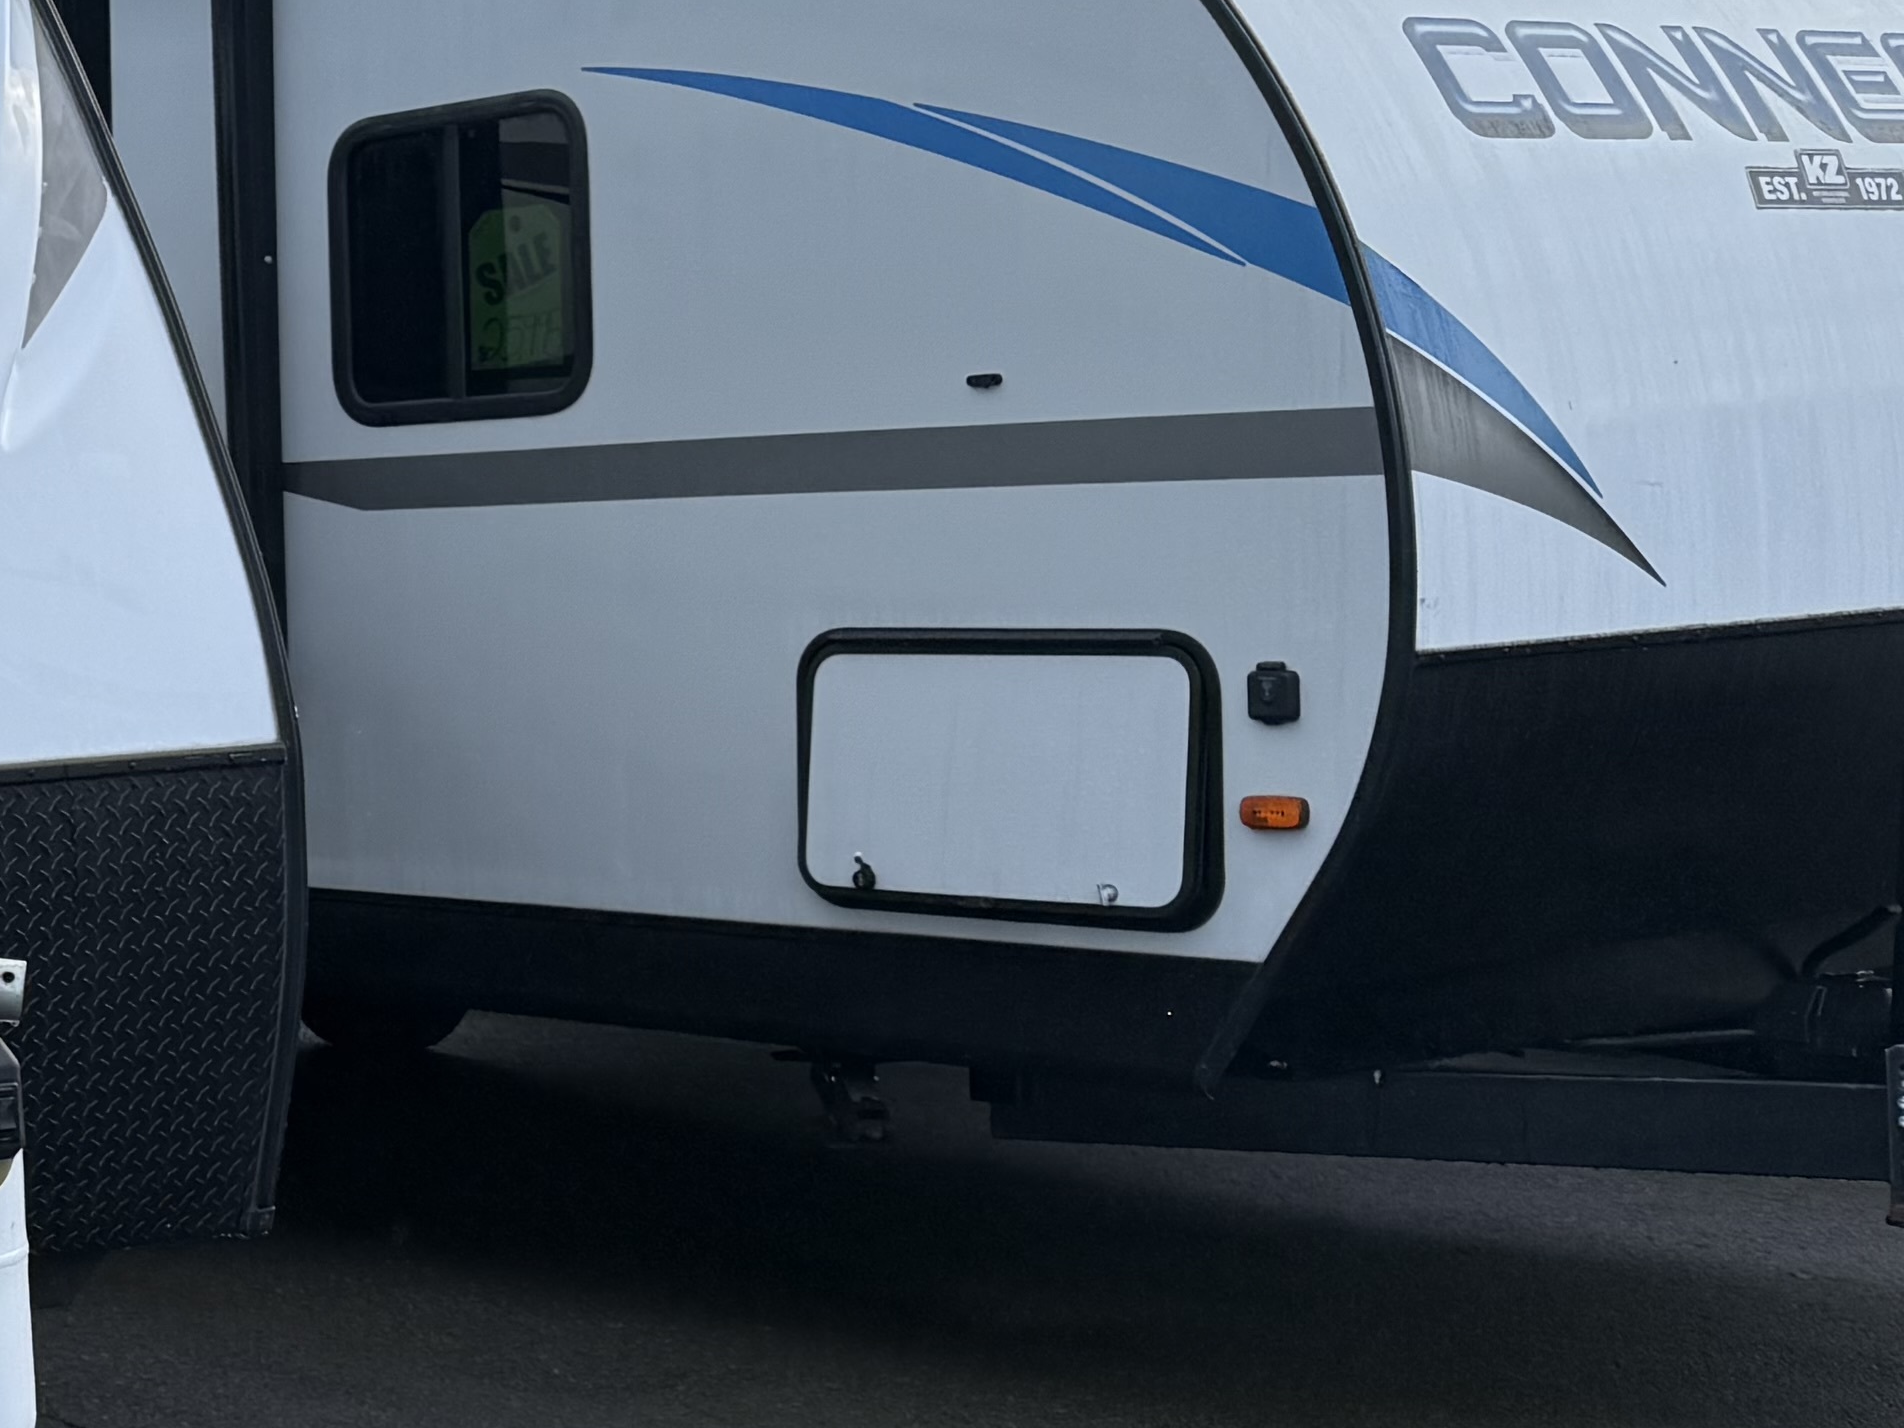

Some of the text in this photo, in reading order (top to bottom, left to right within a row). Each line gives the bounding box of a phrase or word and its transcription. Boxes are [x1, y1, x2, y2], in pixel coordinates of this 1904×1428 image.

[1402, 16, 1904, 143] CONNE
[1758, 176, 1807, 200] EST.
[1855, 176, 1903, 200] 1972
[1800, 154, 1846, 184] KZ
[476, 231, 557, 306] SALE
